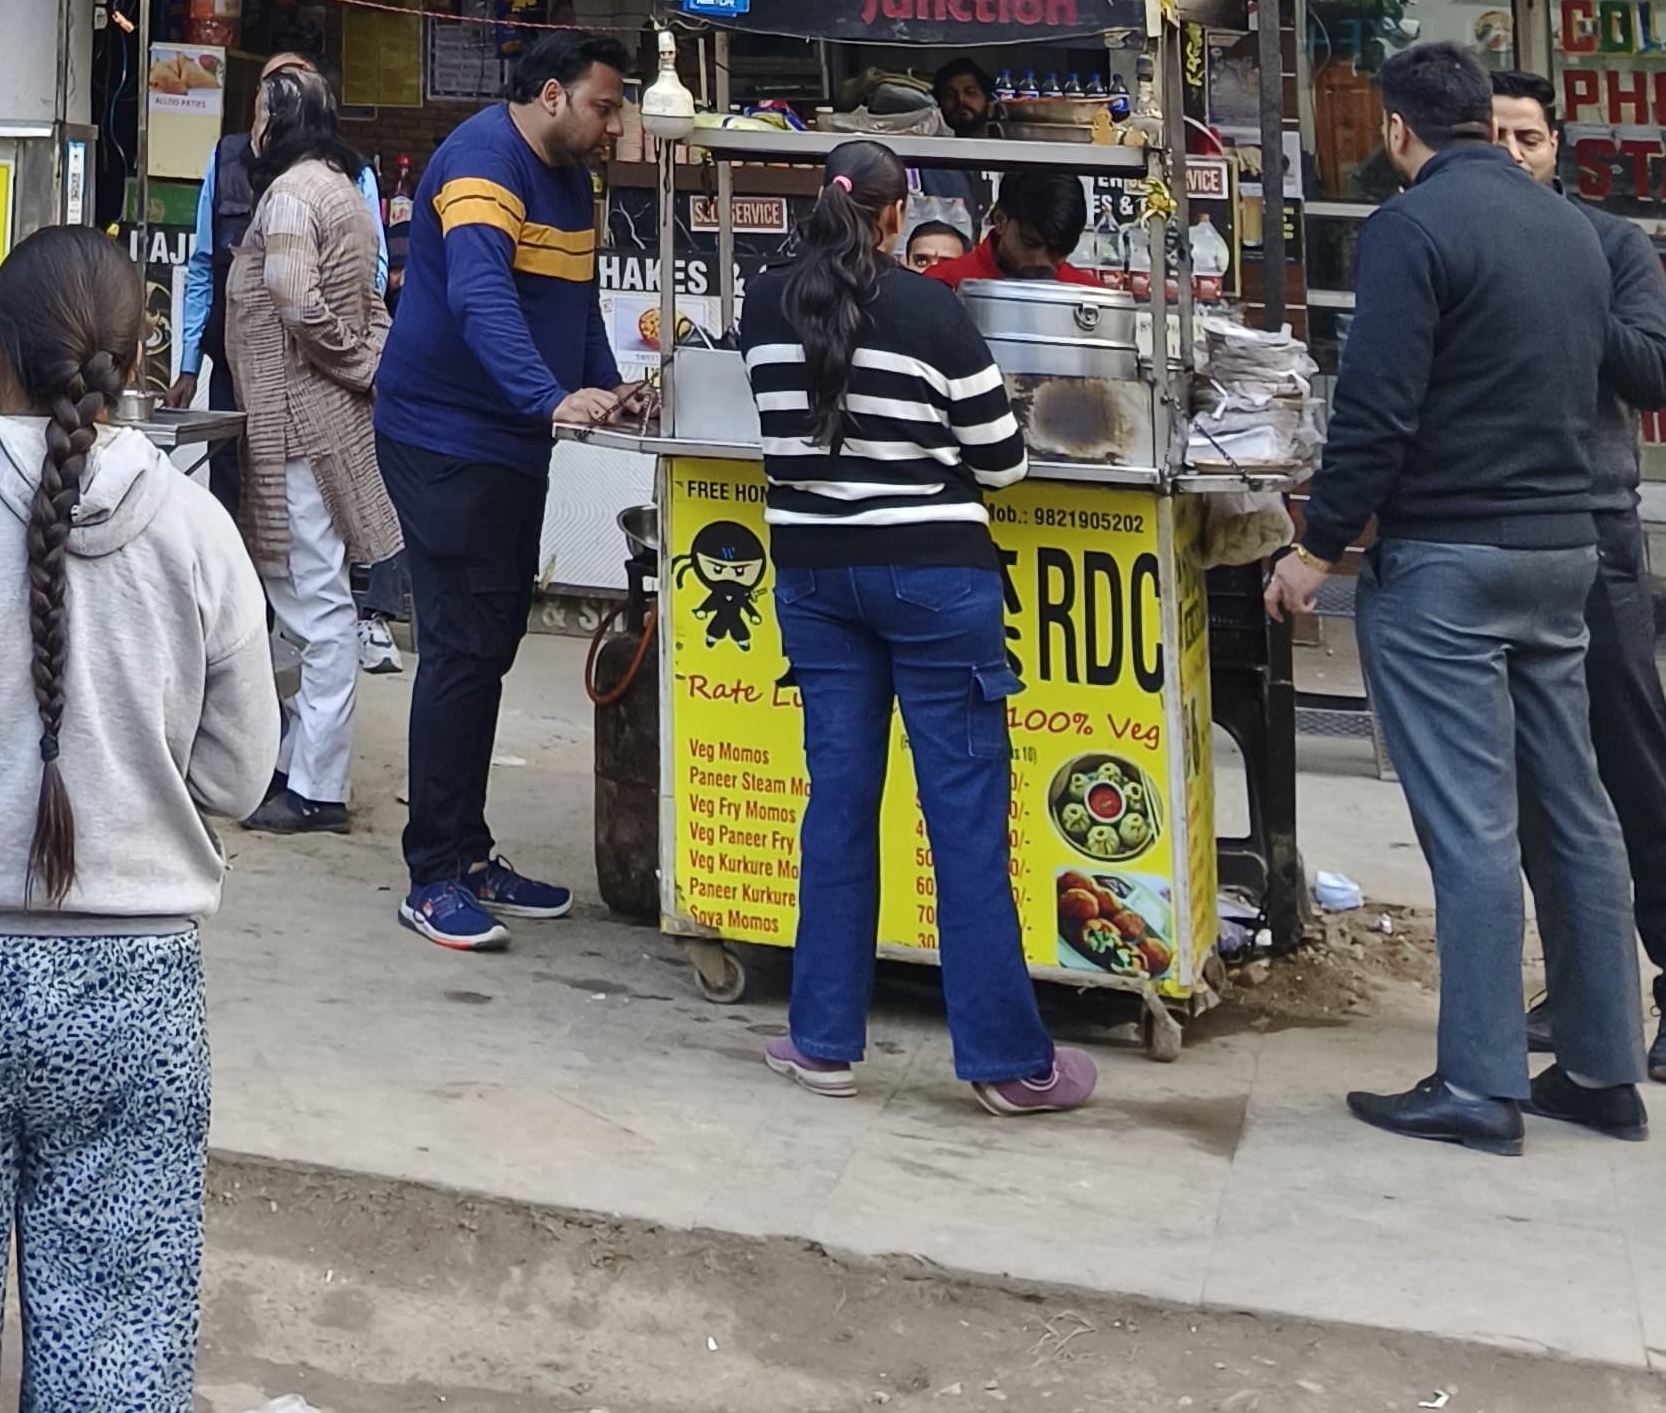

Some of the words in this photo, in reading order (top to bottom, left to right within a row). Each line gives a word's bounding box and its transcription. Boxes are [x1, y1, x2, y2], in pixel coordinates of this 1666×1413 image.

[687, 481, 729, 501] FREE
[1034, 507, 1145, 534] 9821905202
[1037, 548, 1164, 694] RDC
[689, 675, 763, 703] Rate
[1010, 706, 1093, 736] 100%
[1107, 714, 1160, 750] Veg
[689, 739, 716, 761] Veg
[719, 742, 769, 766] Momos
[689, 768, 738, 789] Paneer
[742, 771, 787, 795] Steam
